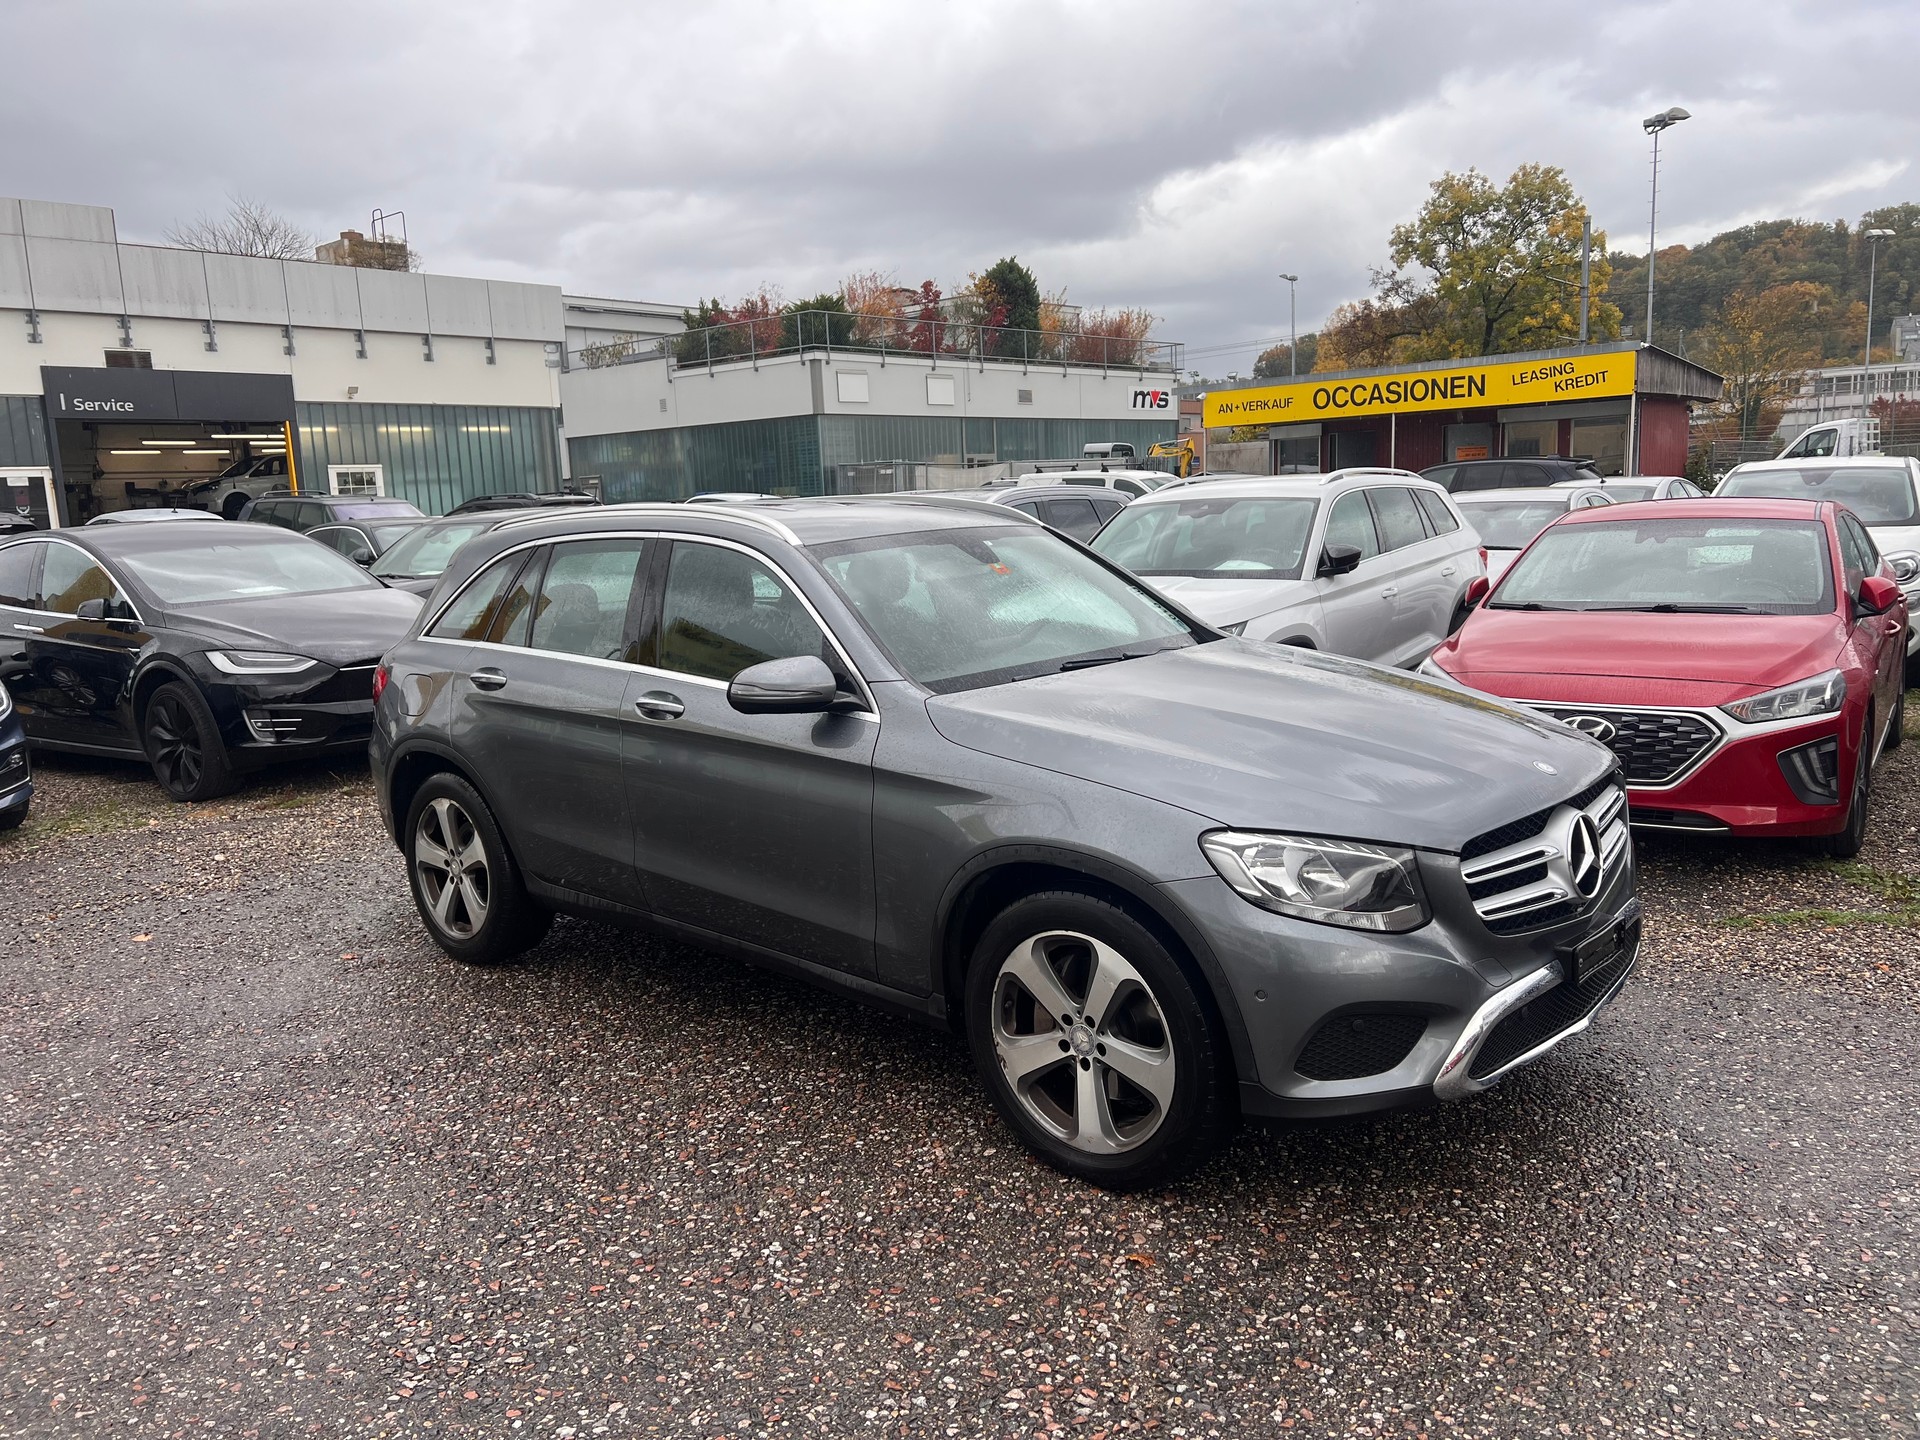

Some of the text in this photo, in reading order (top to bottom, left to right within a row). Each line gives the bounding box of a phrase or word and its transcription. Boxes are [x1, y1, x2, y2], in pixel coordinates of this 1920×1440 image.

[1512, 362, 1575, 386] LEASING
[1554, 370, 1609, 393] KREDIT
[1312, 374, 1486, 410] OCCASIONEN
[73, 398, 134, 412] Service
[1241, 397, 1294, 412] VERKAUF
